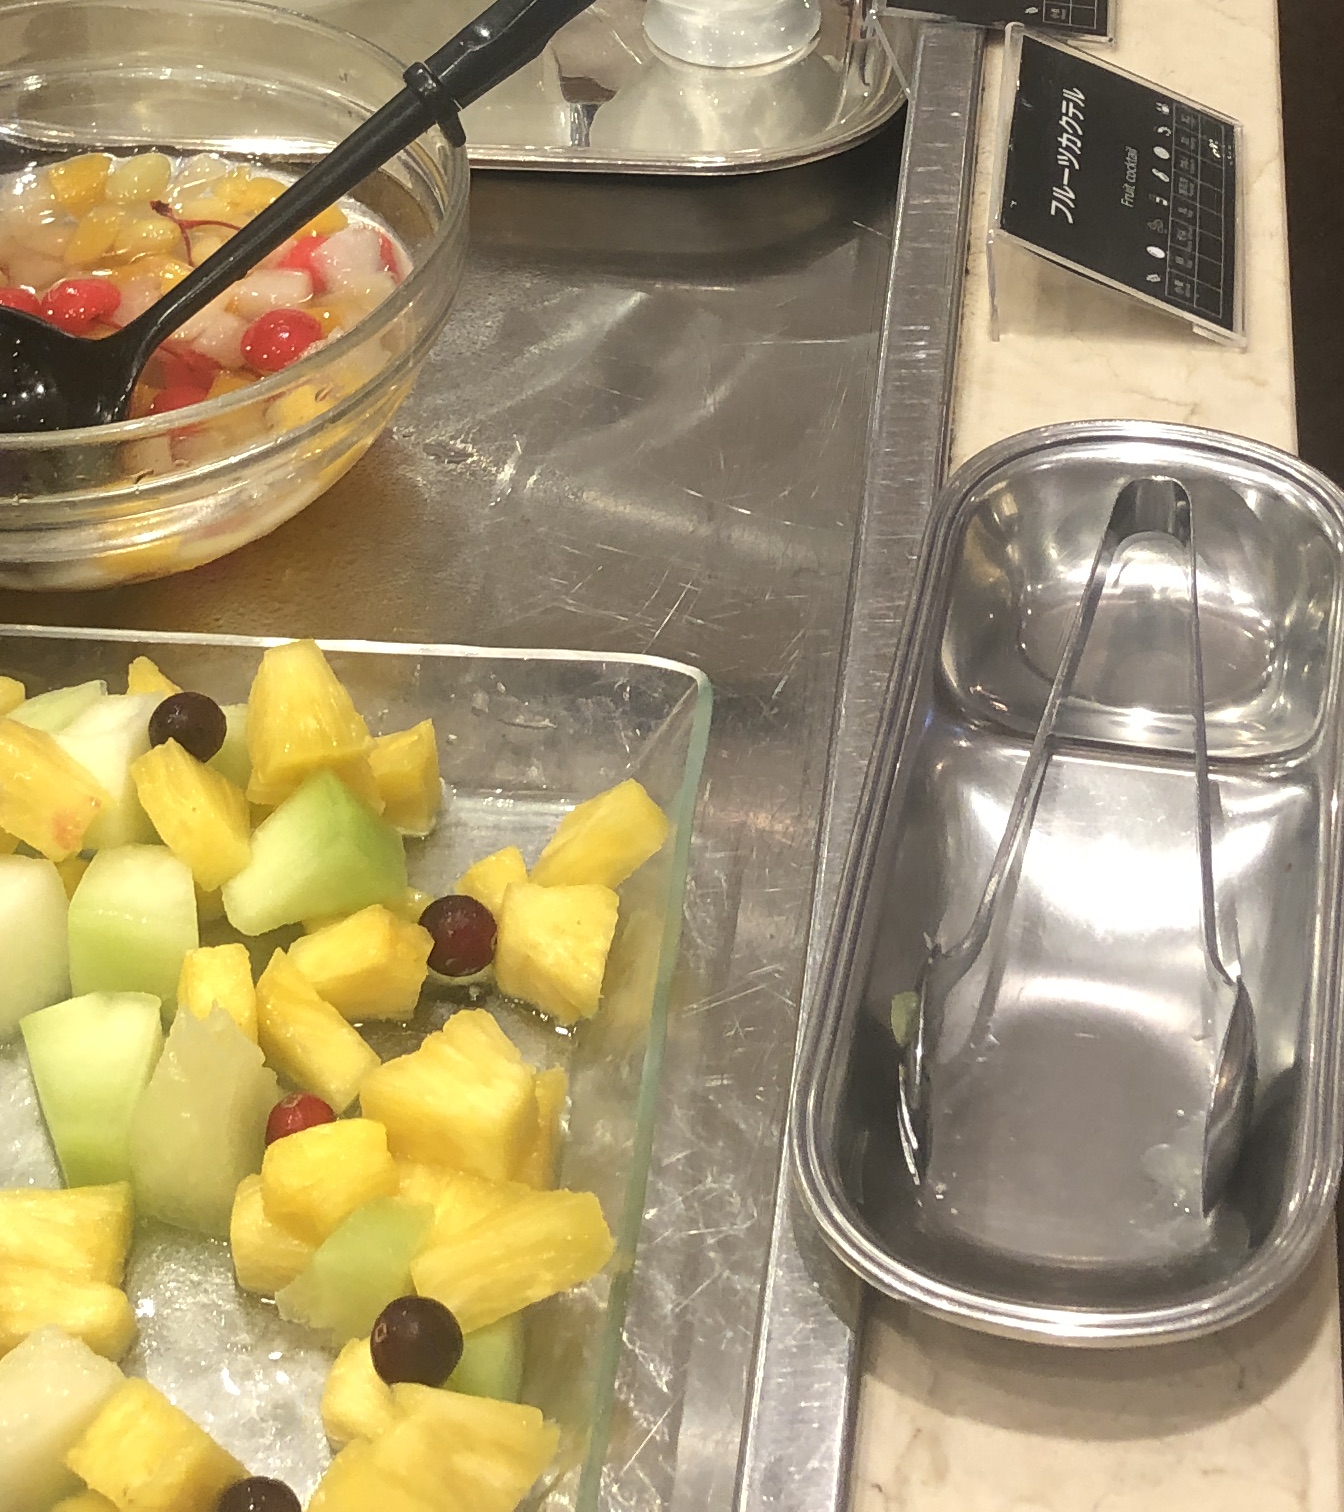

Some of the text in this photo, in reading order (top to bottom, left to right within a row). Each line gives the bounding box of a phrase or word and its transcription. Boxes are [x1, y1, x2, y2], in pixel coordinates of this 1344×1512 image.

[1049, 86, 1087, 225] フルーツカクテル
[1119, 145, 1140, 208] Fruit cocktail
